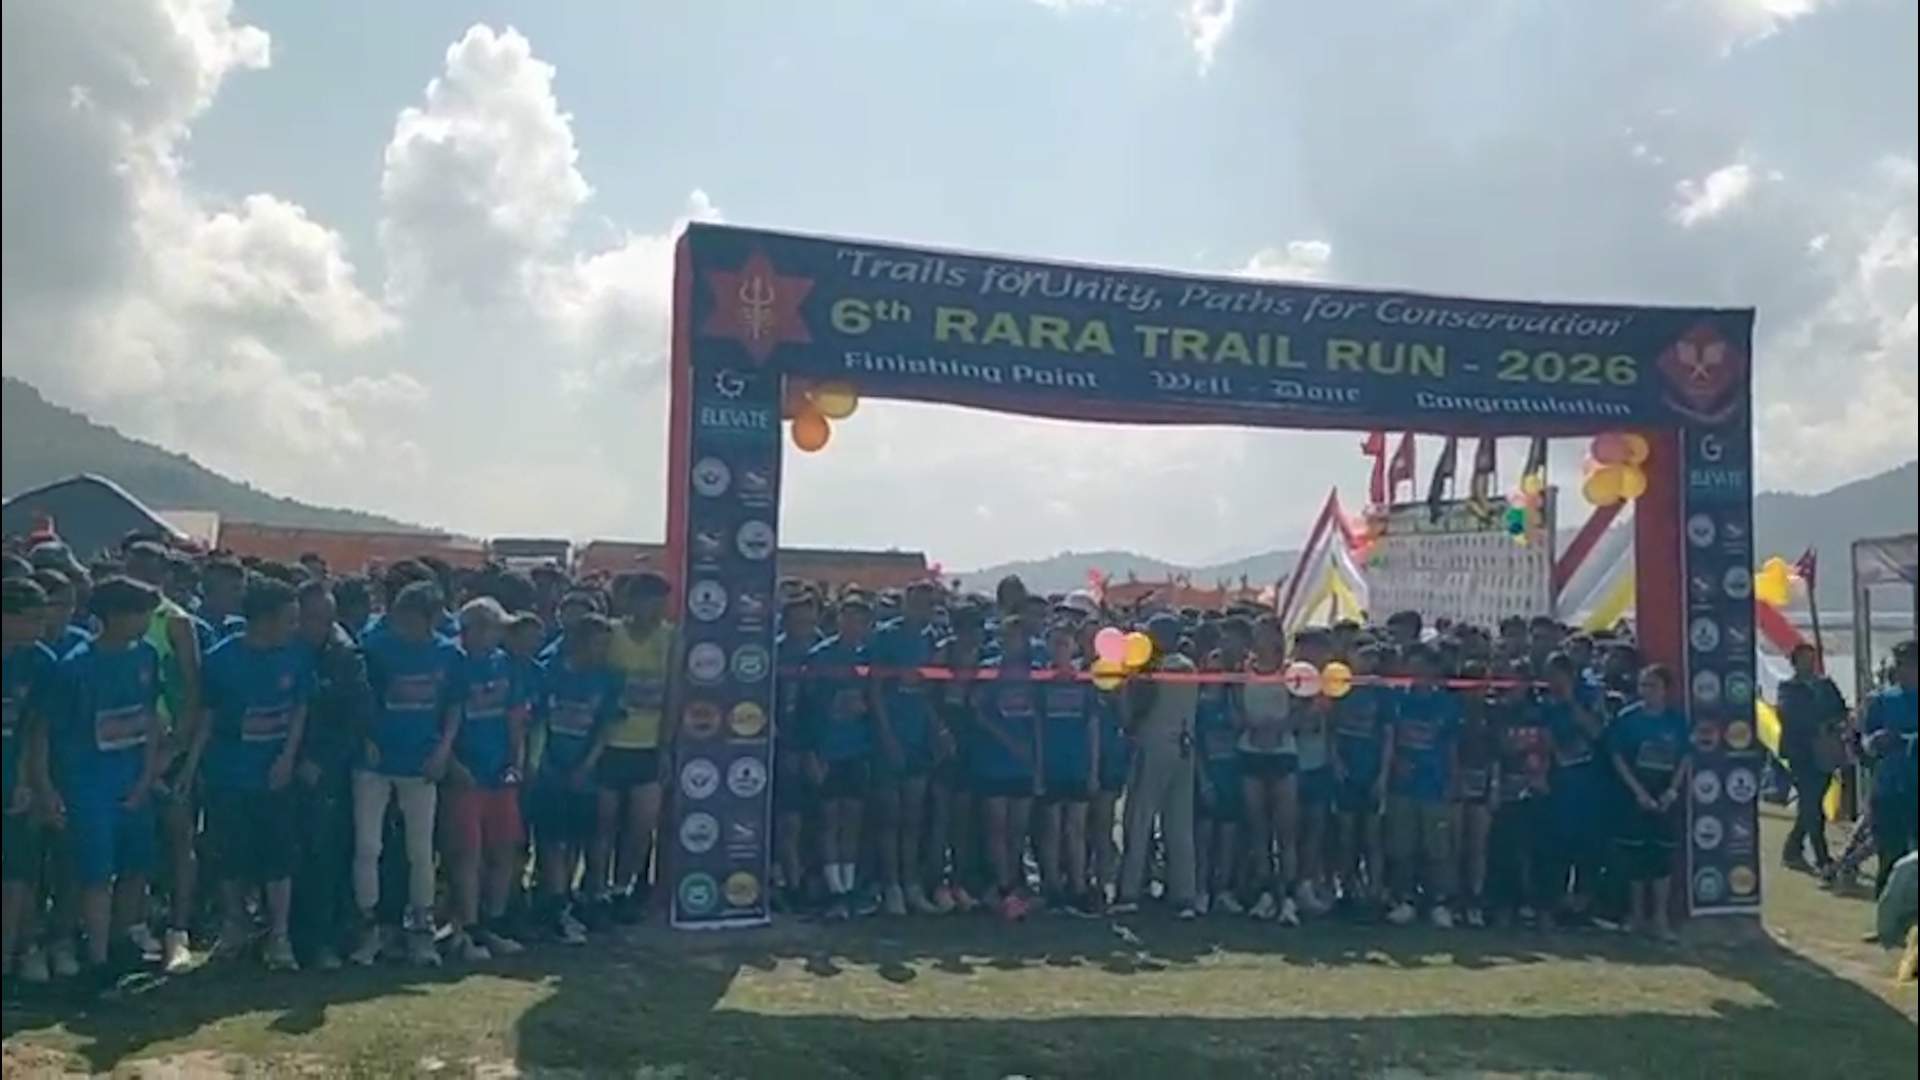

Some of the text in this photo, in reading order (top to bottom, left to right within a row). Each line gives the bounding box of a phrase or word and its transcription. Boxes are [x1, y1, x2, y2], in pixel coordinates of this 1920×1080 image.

[1179, 283, 1293, 316] Paths
[1302, 293, 1367, 325] for
[831, 299, 911, 335] 6th
[935, 306, 1115, 355] RARA
[1134, 324, 1307, 369] TRAIL
[1325, 338, 1445, 377] RUN
[1496, 349, 1638, 385] 2026
[843, 351, 1099, 387] Finishing Point
[1150, 369, 1233, 394] Well
[1268, 378, 1361, 401] Done
[701, 406, 769, 428] ELEVATE
[1415, 391, 1632, 416] Congratulation
